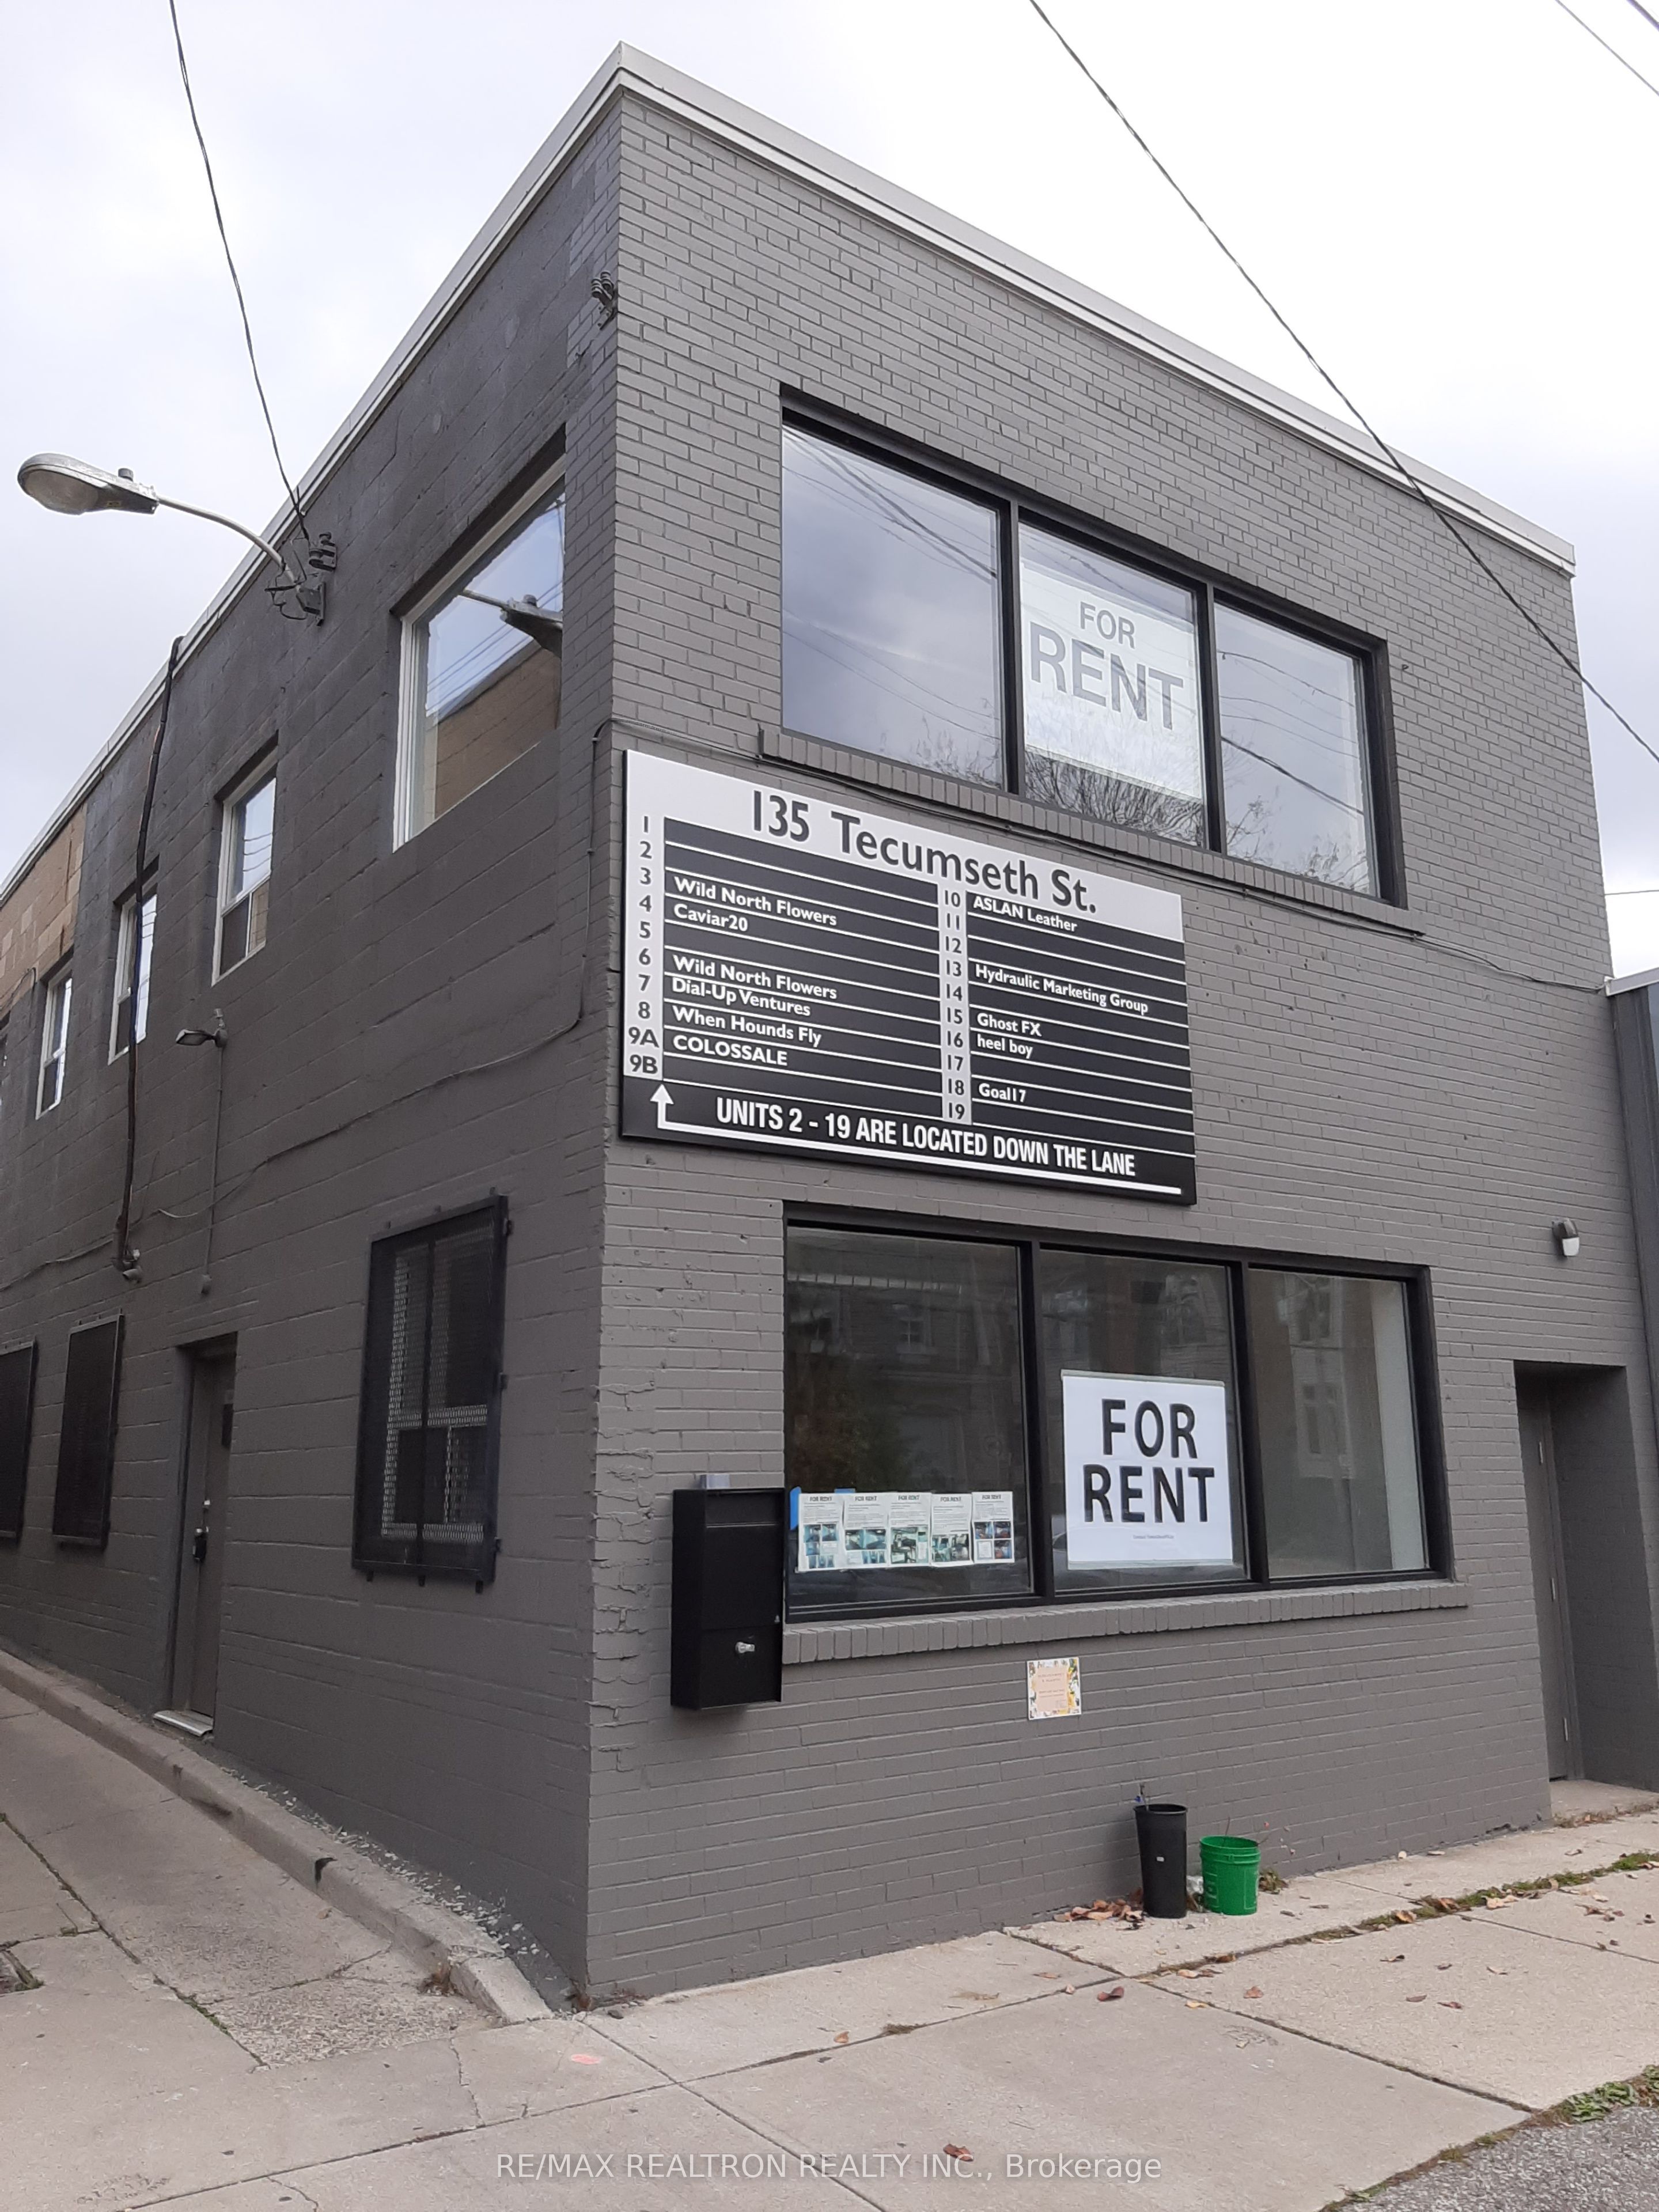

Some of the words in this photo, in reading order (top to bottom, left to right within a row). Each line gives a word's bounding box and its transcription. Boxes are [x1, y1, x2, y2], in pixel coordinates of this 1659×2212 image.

[1080, 601, 1135, 649] FOR
[1030, 621, 1184, 730] RENT
[644, 816, 648, 832] 1
[641, 841, 652, 858] 2
[754, 790, 809, 842] 135
[831, 811, 1039, 900] Tecumseth
[1052, 869, 1096, 913] St.
[639, 895, 651, 912] 4
[675, 904, 747, 931] Caviar20
[641, 868, 651, 884] 3
[675, 877, 715, 899] Wild
[722, 888, 771, 911] North
[777, 900, 836, 925] Flowers
[945, 891, 960, 907] 10
[974, 896, 1023, 918] ASLAN
[1028, 908, 1077, 931] Leather
[640, 921, 650, 938] 5
[946, 913, 959, 930] 11
[946, 936, 961, 953] 12
[639, 948, 650, 965] 6
[673, 955, 714, 976] Wild
[721, 964, 771, 987] North
[777, 975, 836, 999] Flowers
[946, 960, 961, 976] 13
[976, 964, 1040, 989] Hydraulic
[1044, 979, 1107, 1007] Marketing
[1110, 993, 1149, 1016] Group
[639, 974, 650, 991] 7
[672, 976, 737, 1006] Dial-Up
[740, 989, 811, 1017] Ventures
[947, 984, 962, 1001] 14
[638, 1002, 650, 1018] 8
[673, 1006, 725, 1028] When
[732, 1016, 793, 1039] Hounds
[799, 1027, 821, 1047] Fly
[947, 1007, 962, 1024] 15
[978, 1013, 1018, 1032] Ghost
[1022, 1021, 1041, 1036] FX
[628, 1027, 659, 1047] 9A
[673, 1035, 787, 1066] COLOSSALE
[948, 1031, 963, 1047] 16
[978, 1034, 1005, 1051] heel
[1009, 1040, 1033, 1059] boy
[948, 1055, 963, 1071] 17
[630, 1055, 657, 1074] 9B
[949, 1079, 964, 1095] 18
[949, 1103, 964, 1119] 19
[718, 1097, 782, 1129] UNITS
[789, 1108, 802, 1132] 2
[825, 1113, 850, 1138] 19
[856, 1118, 896, 1144] ARE
[903, 1123, 987, 1156] LOCATED
[994, 1136, 1048, 1164] DOWN
[1053, 1144, 1086, 1169] THE
[1092, 1150, 1135, 1176] LANE
[1103, 1399, 1197, 1459] FOR
[1084, 1464, 1214, 1522] RENT
